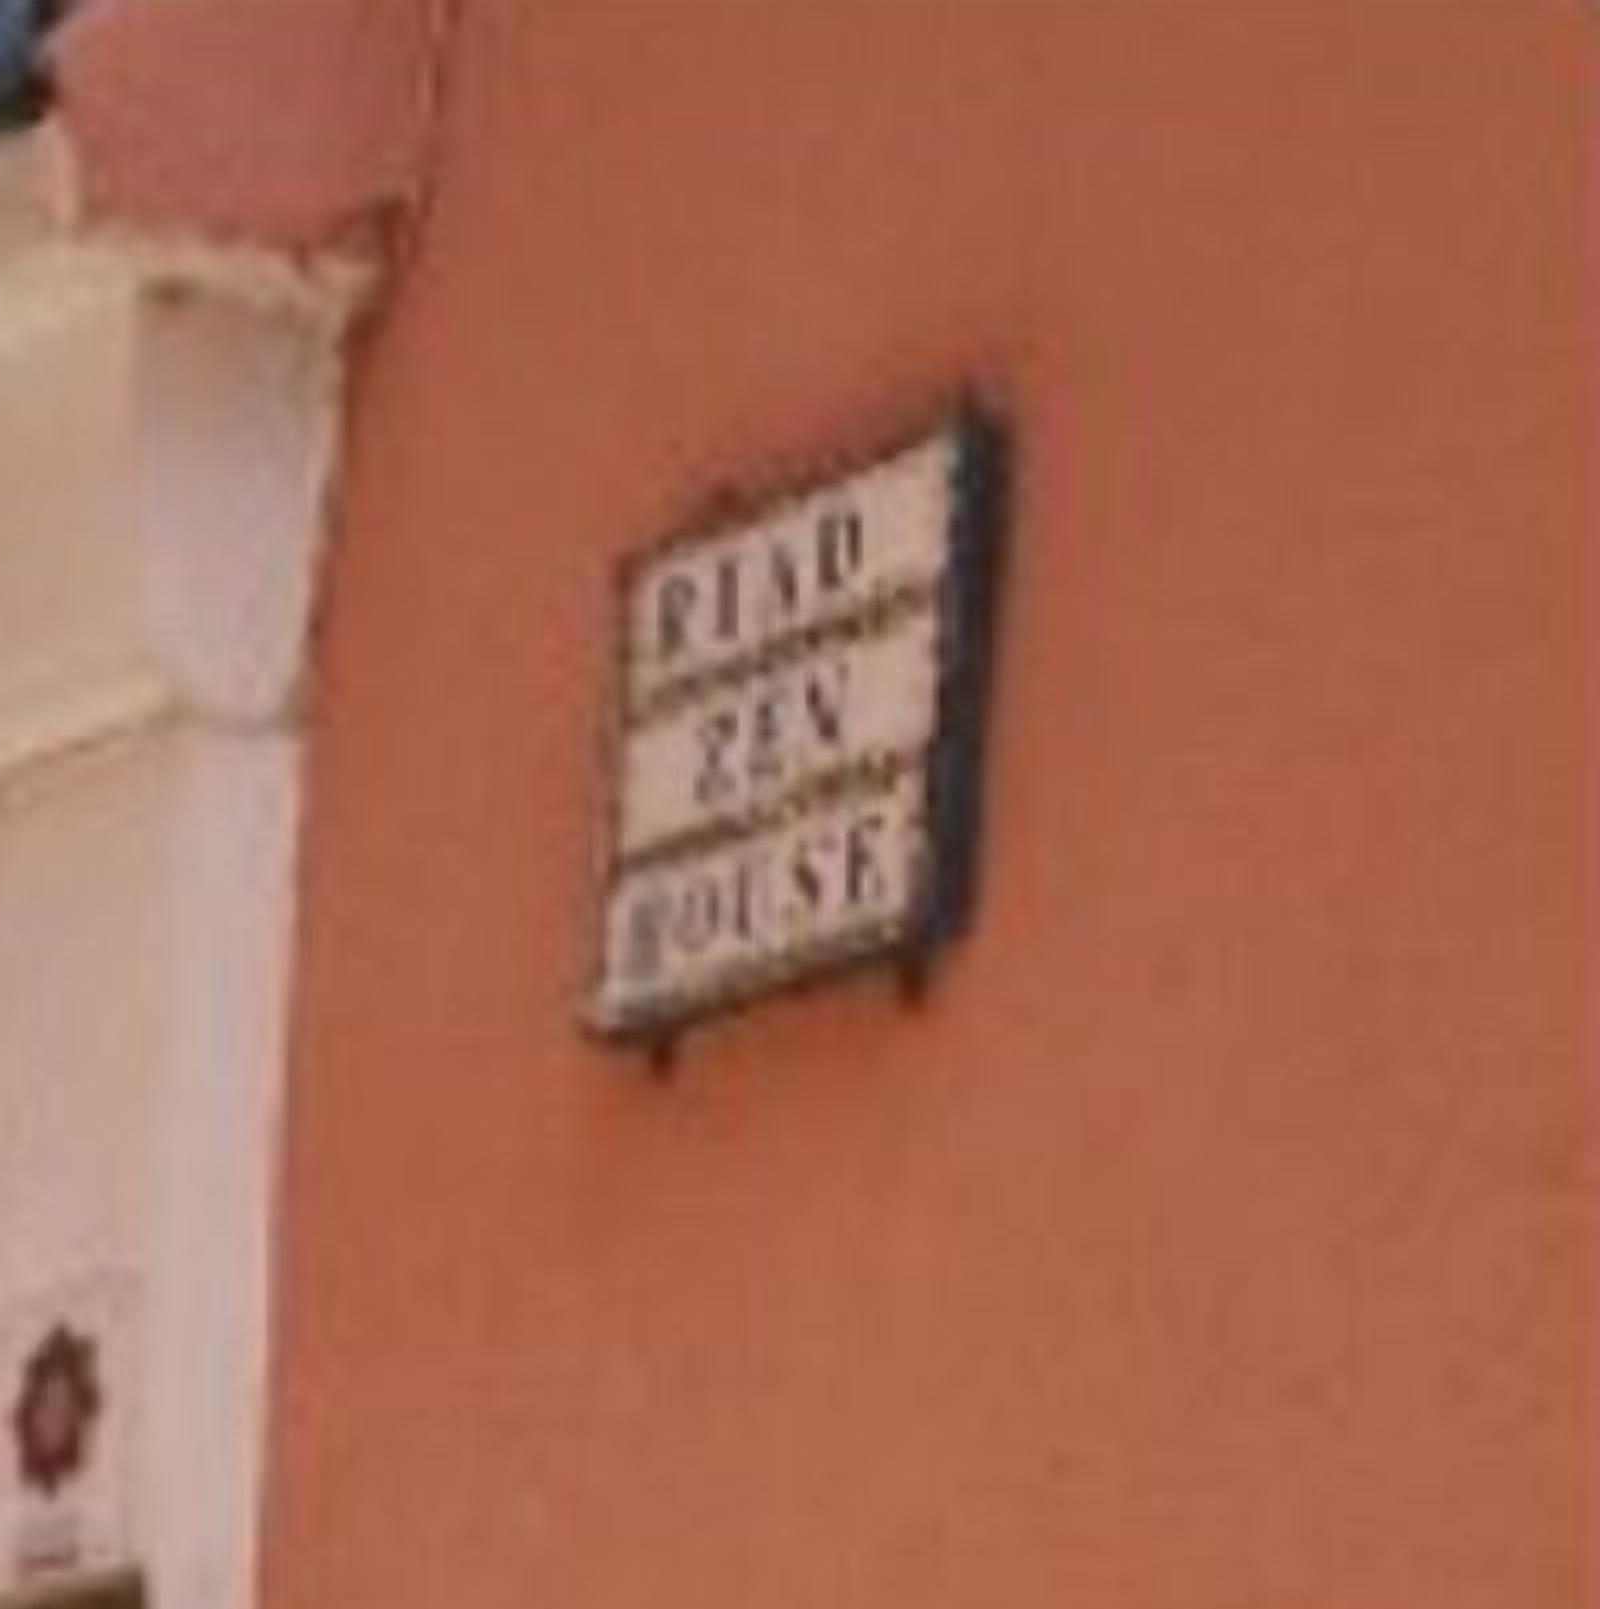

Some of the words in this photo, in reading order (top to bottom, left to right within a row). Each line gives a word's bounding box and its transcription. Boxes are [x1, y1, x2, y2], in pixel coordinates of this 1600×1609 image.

[655, 512, 865, 658] RIAD
[692, 658, 851, 805] ZEN
[624, 813, 886, 980] HOUSE
